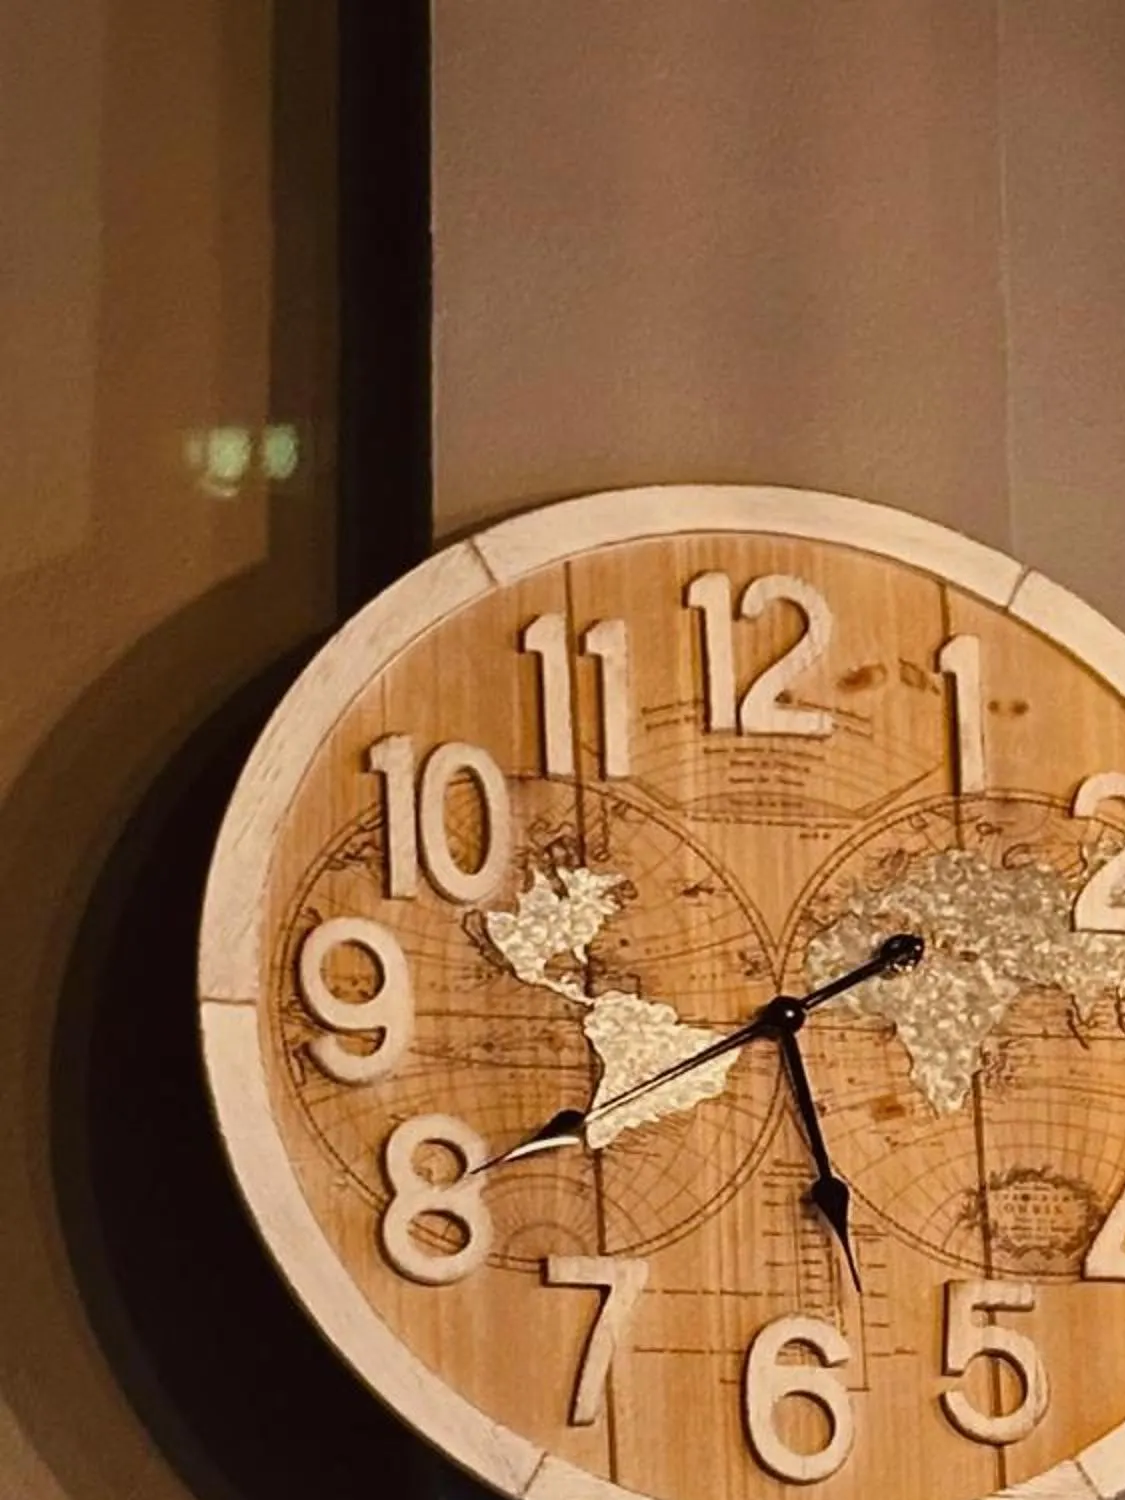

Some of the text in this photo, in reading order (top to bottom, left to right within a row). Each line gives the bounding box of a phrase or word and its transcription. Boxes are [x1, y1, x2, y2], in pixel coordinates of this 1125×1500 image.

[521, 613, 630, 779] 11
[685, 572, 833, 736] 12
[936, 634, 986, 794] 1
[369, 734, 510, 901] 10
[299, 916, 413, 1085] 9
[381, 1113, 492, 1285] 8
[541, 1256, 649, 1426] 7
[742, 1314, 854, 1485] 6
[941, 1281, 1049, 1445] 5
